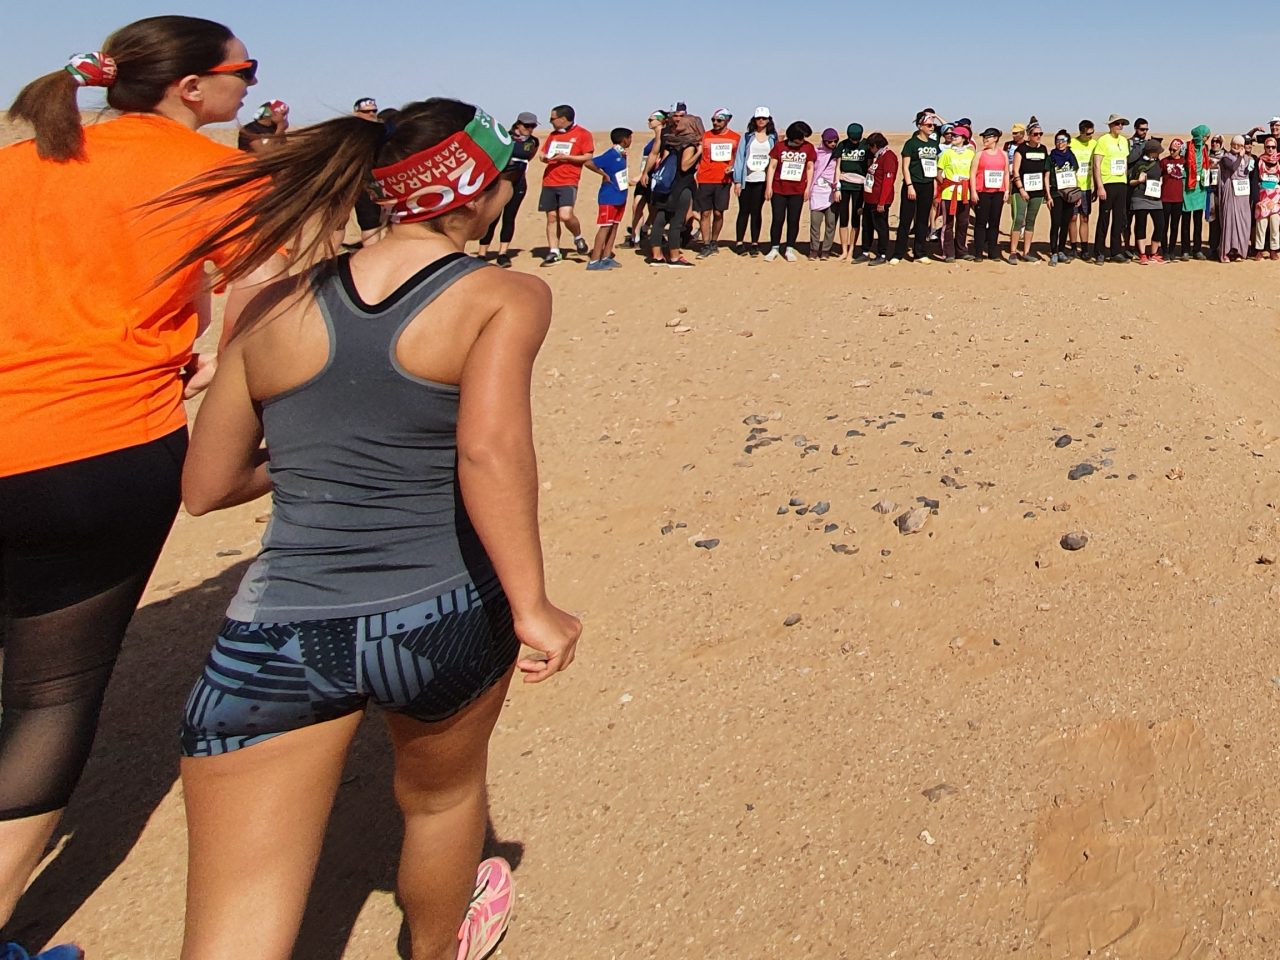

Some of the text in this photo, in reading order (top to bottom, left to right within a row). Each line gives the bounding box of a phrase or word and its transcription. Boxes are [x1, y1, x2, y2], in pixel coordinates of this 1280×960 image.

[386, 140, 460, 186] MARATHON
[394, 147, 469, 192] SAHARA
[781, 151, 807, 159] 2020
